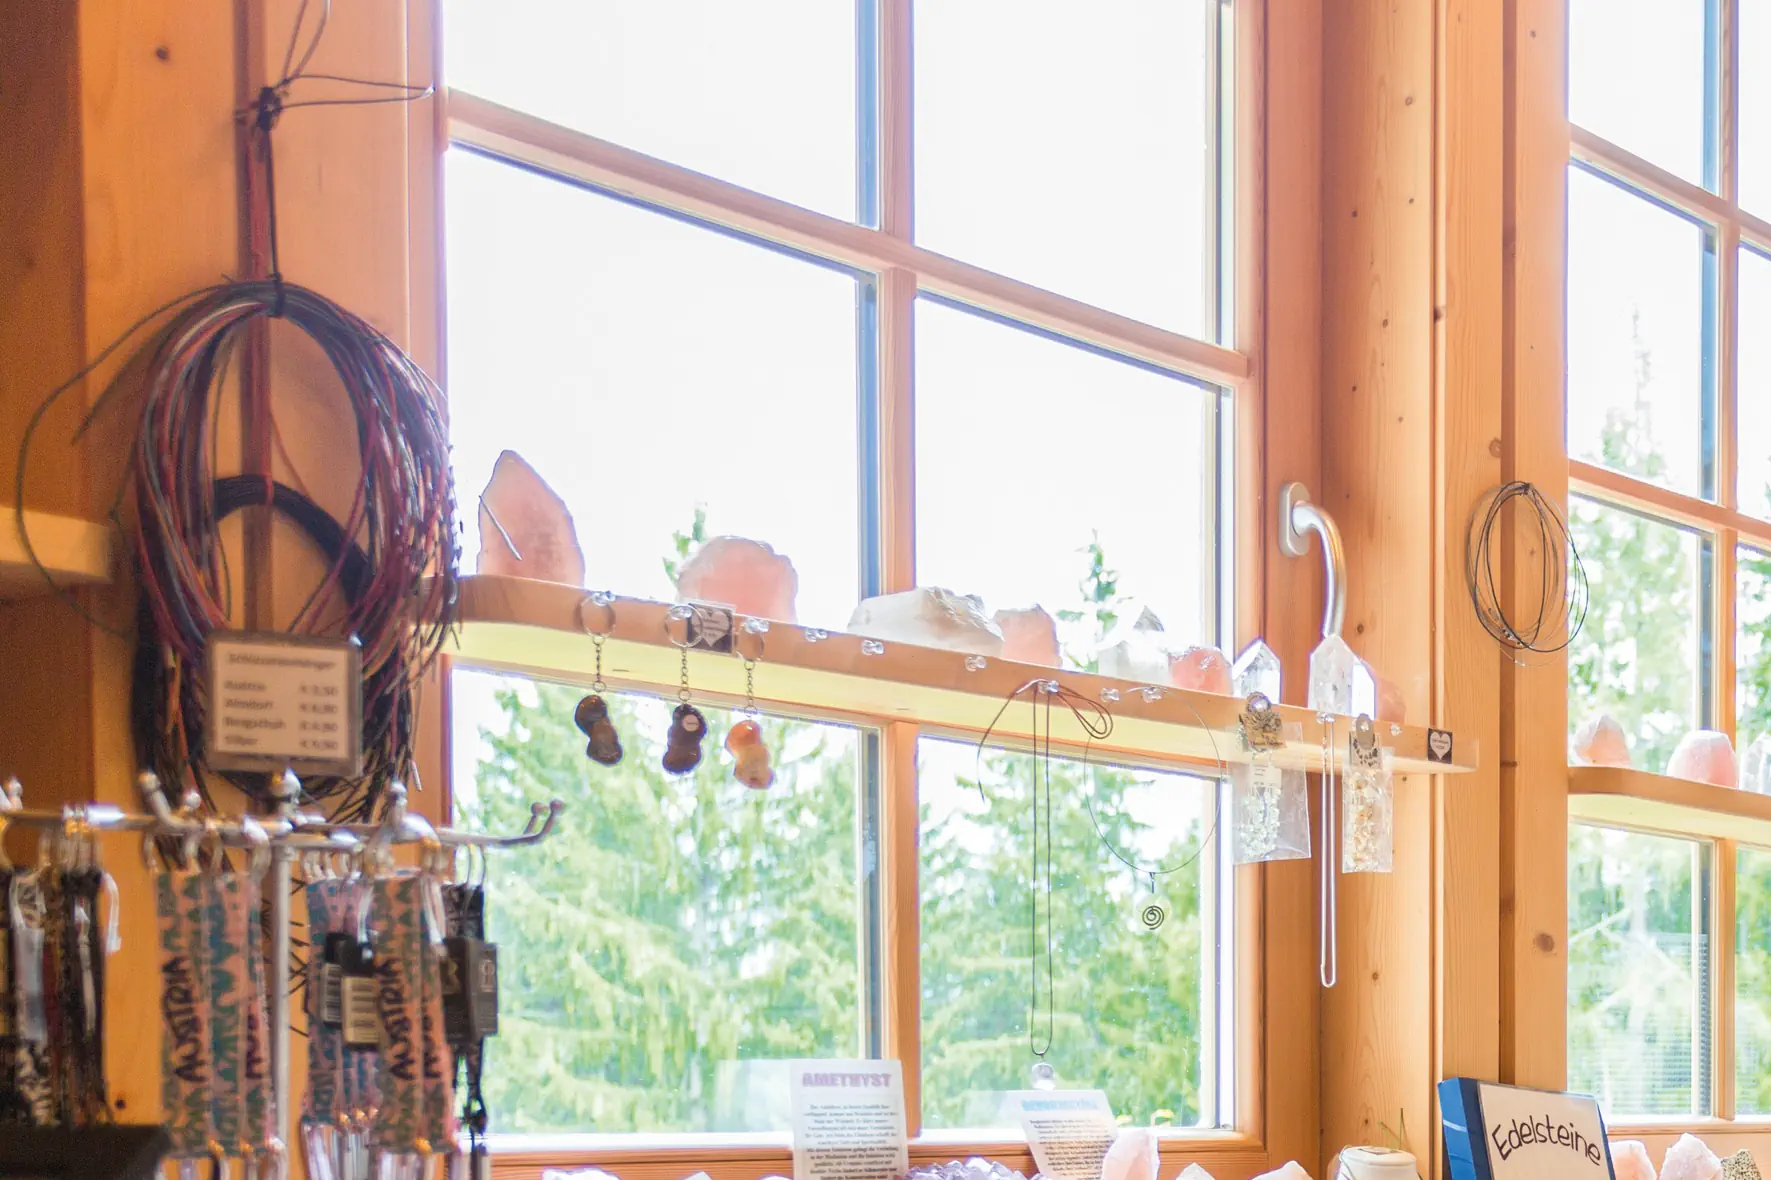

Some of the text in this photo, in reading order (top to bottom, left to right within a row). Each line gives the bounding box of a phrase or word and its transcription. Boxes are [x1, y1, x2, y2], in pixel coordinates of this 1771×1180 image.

[162, 956, 208, 1082] AUSTRIA
[374, 957, 417, 1081] AUSTRIA
[802, 1073, 892, 1087] AMETHYST
[1491, 1114, 1602, 1167] Edelsteine
